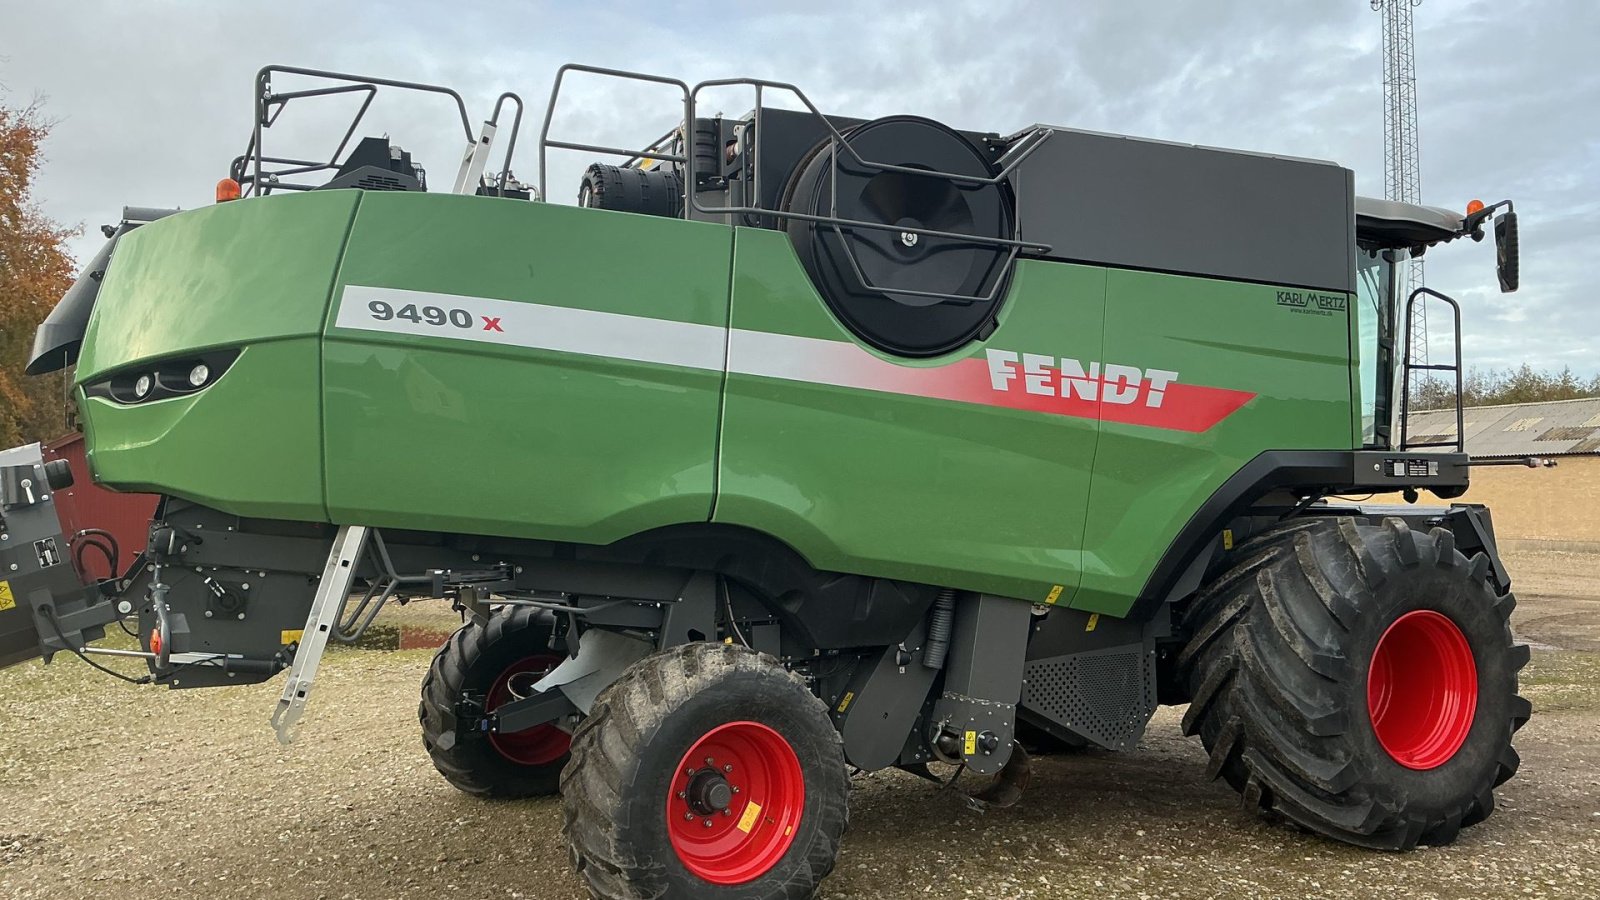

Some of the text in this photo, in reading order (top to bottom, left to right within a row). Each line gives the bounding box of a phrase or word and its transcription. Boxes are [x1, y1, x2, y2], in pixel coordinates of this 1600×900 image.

[368, 300, 473, 329] 9490
[1276, 291, 1346, 309] KARL MERTZ
[985, 348, 1179, 408] FENDT
